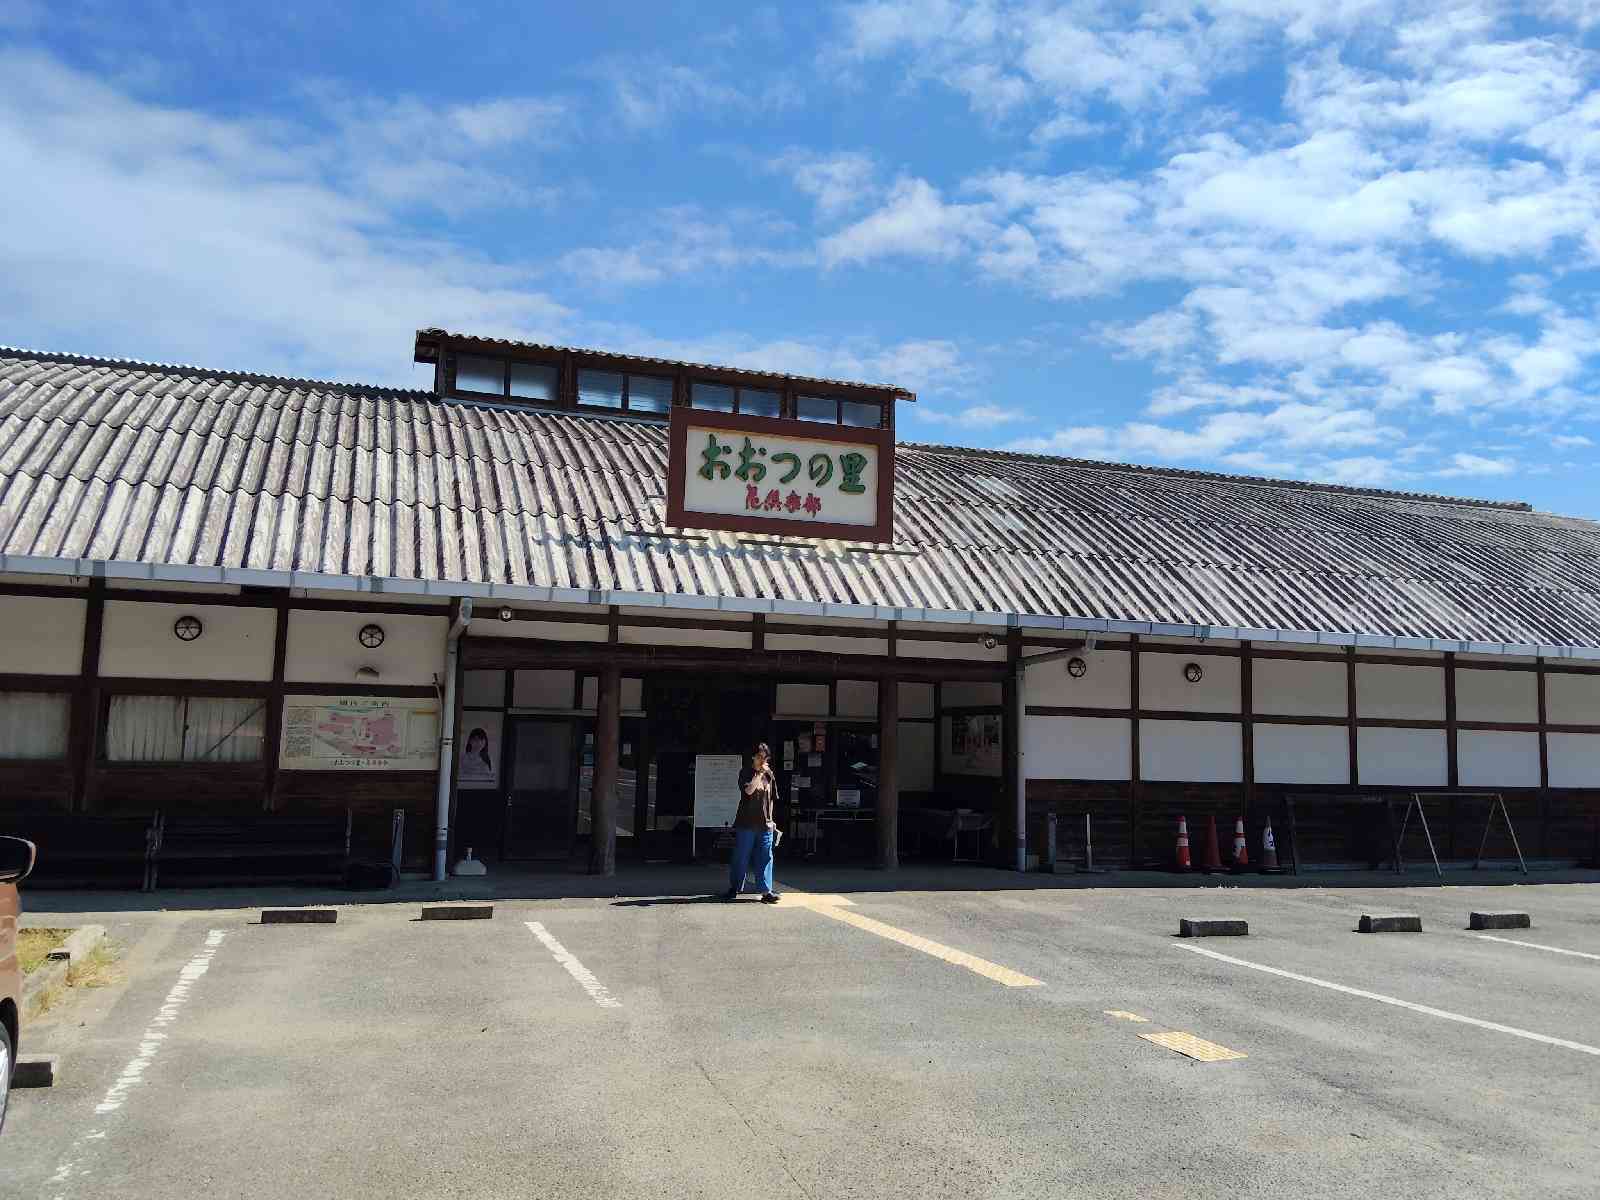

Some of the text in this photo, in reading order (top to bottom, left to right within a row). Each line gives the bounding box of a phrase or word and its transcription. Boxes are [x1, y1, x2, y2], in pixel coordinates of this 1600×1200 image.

[698, 433, 868, 494] おおつの里
